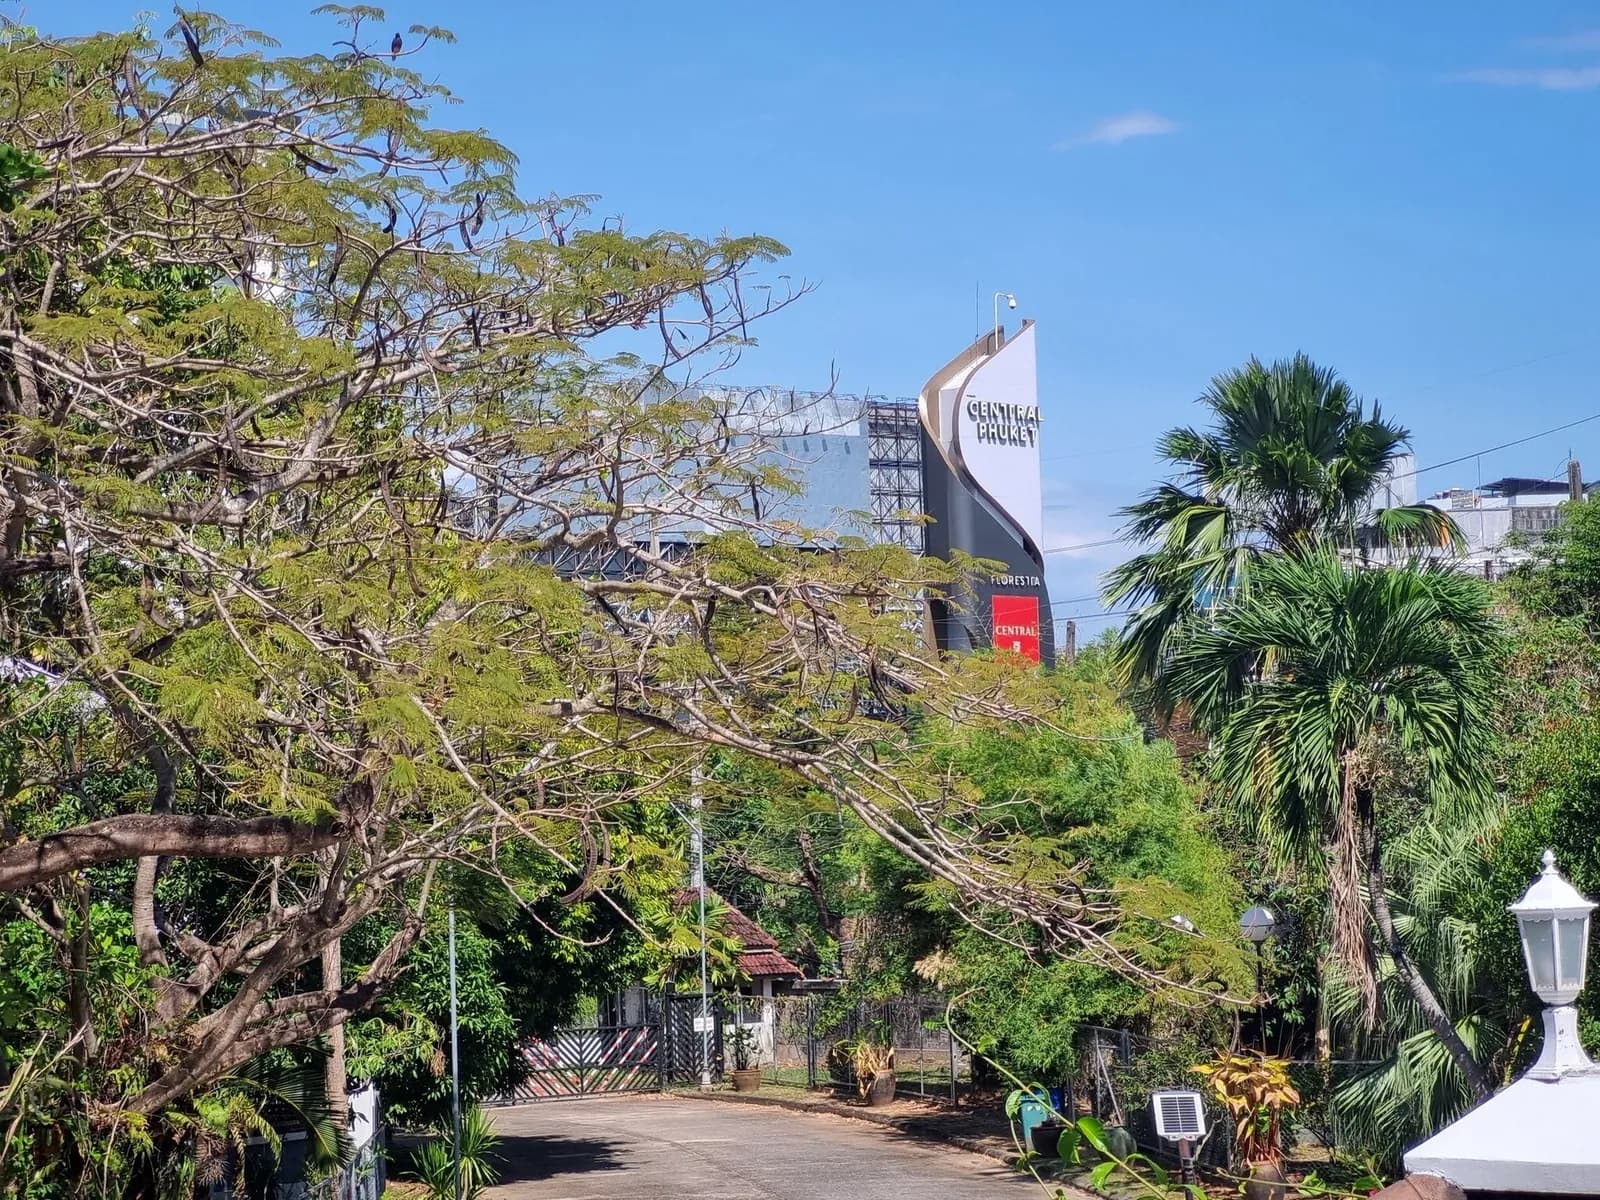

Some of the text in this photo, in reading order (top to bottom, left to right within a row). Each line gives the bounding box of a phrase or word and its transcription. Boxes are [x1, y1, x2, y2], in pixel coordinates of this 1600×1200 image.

[967, 400, 1045, 424] CENTRAL
[977, 422, 1037, 446] PHUKET
[991, 575, 1041, 587] FLORESTIA
[995, 625, 1037, 637] CENTRAL
